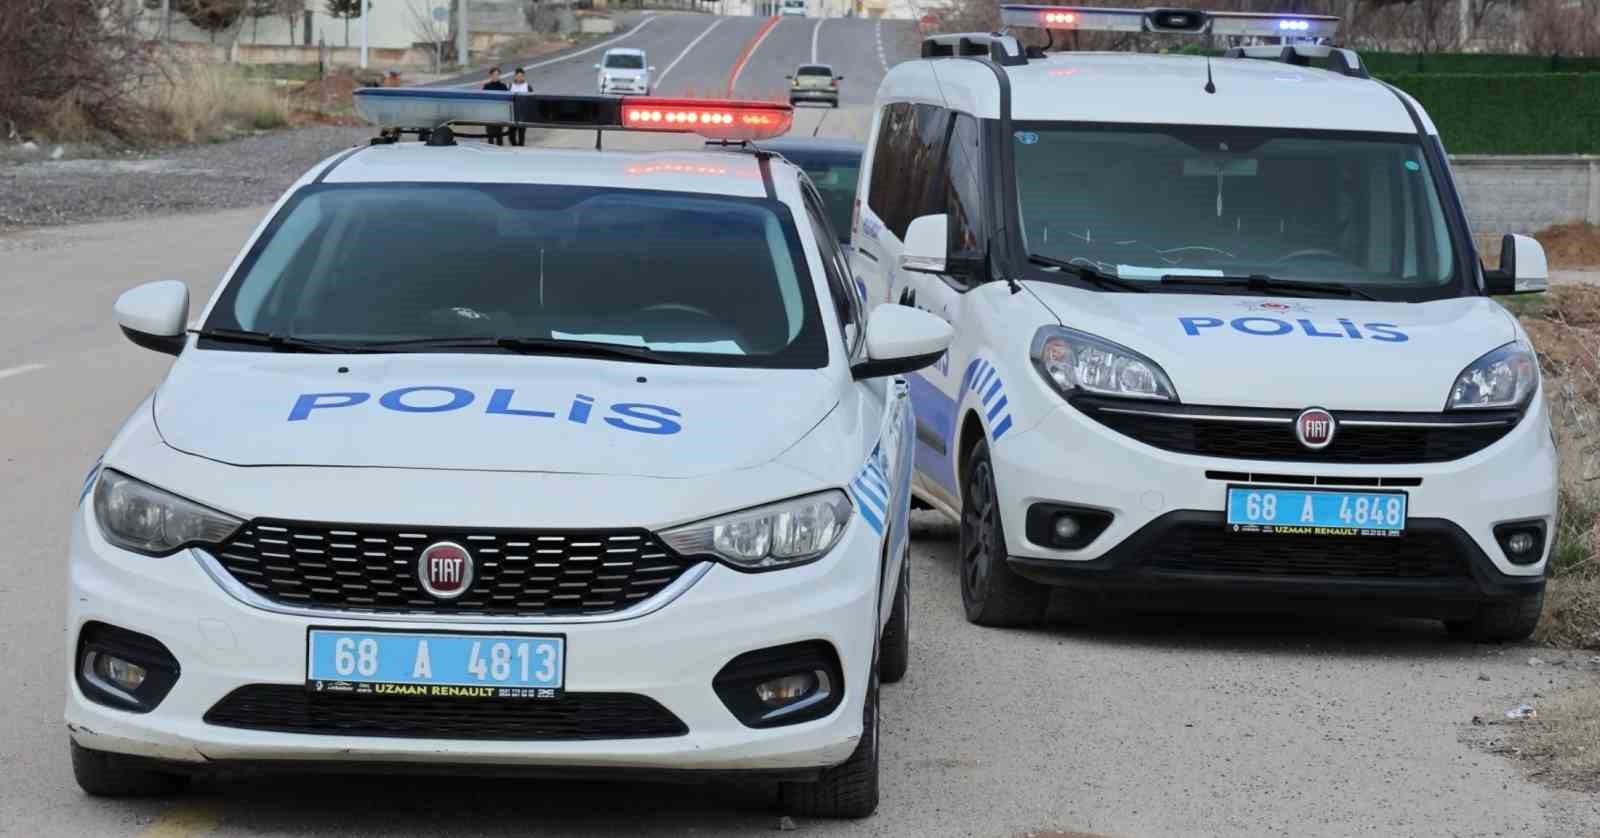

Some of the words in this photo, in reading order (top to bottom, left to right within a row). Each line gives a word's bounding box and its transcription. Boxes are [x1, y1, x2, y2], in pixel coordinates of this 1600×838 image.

[1305, 420, 1328, 438] FIAT
[1246, 493, 1277, 521] 68
[1300, 495, 1314, 522] A
[1339, 496, 1401, 525] 4848
[1314, 527, 1359, 536] RENAULT
[431, 558, 463, 583] FIAT
[335, 637, 378, 677] 68
[412, 639, 432, 679] A
[467, 641, 557, 683] 4813
[375, 685, 426, 695] UZMAN
[431, 686, 495, 697] RENAULT
